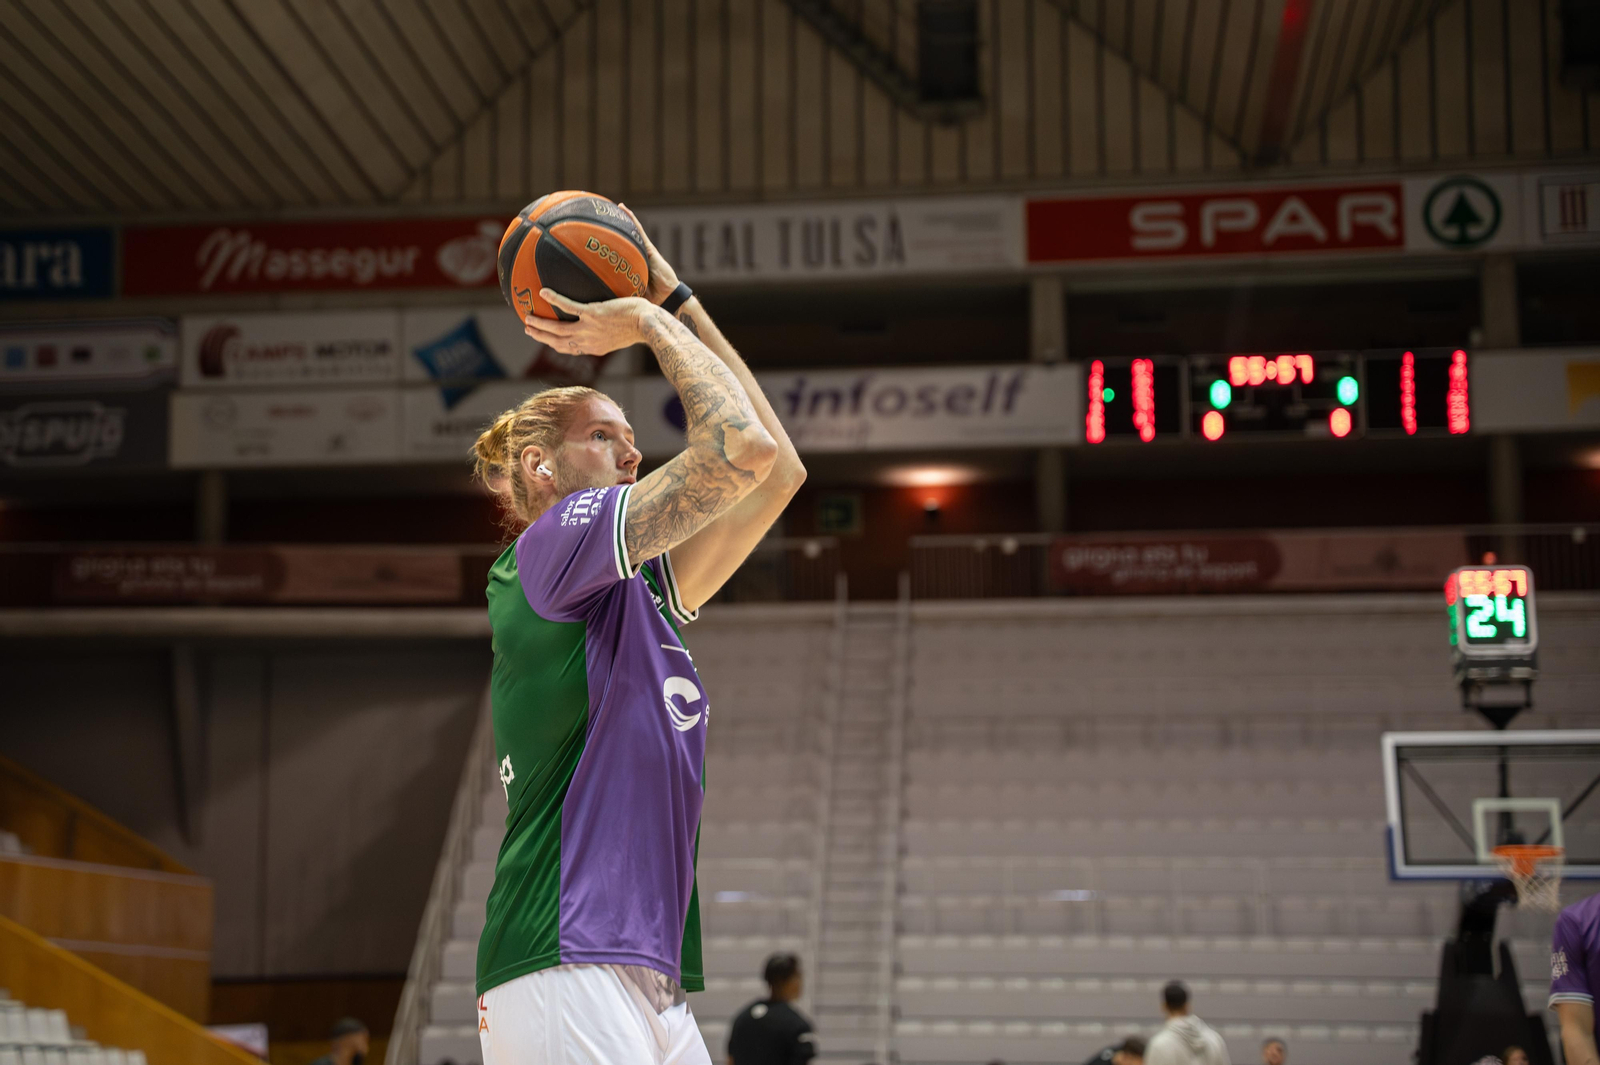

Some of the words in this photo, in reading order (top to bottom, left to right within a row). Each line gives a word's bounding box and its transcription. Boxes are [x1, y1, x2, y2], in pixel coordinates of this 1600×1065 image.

[778, 206, 906, 268] TULSA
[1128, 192, 1398, 250] SPAR
[197, 228, 421, 289] Massegur
[786, 372, 1026, 417] infoself
[1464, 594, 1526, 638] 24
